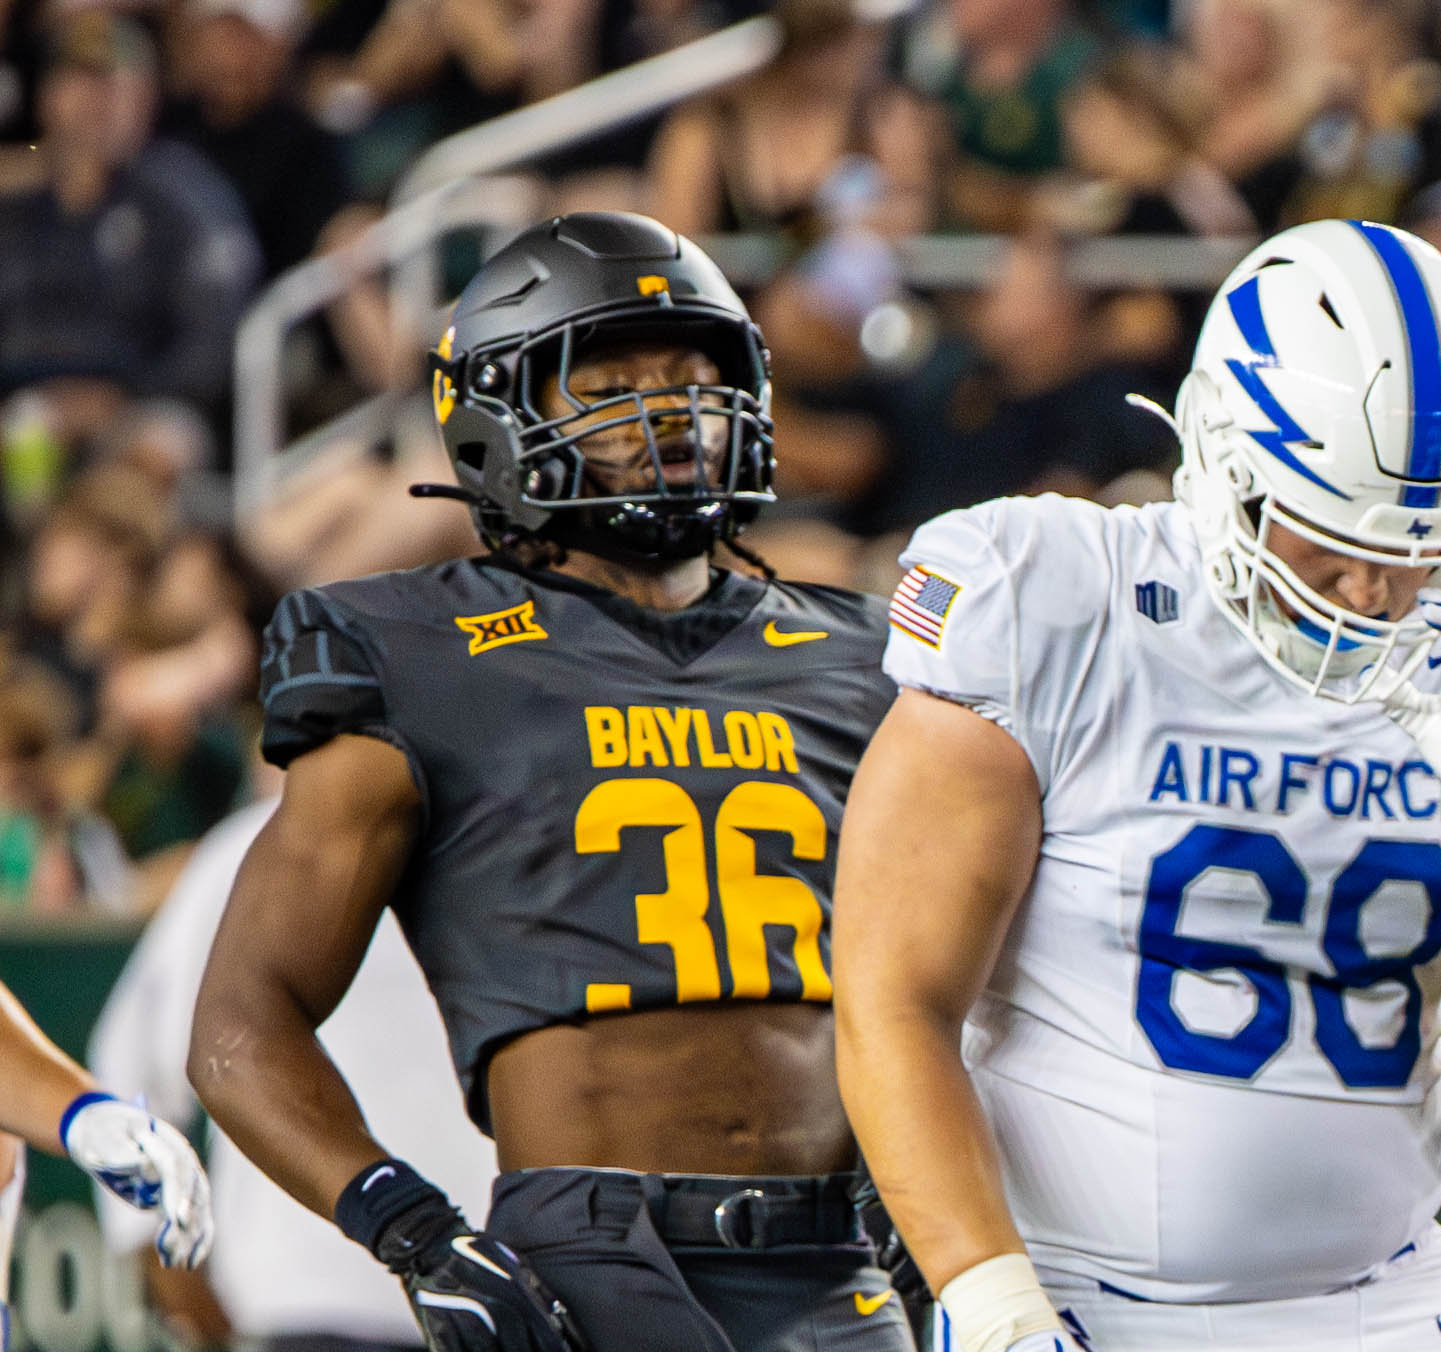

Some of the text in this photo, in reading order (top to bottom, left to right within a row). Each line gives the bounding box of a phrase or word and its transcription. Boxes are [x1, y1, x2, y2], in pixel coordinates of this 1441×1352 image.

[584, 705, 800, 774] BAYLOR
[1149, 739, 1262, 812] AIR
[574, 777, 834, 1013] 36
